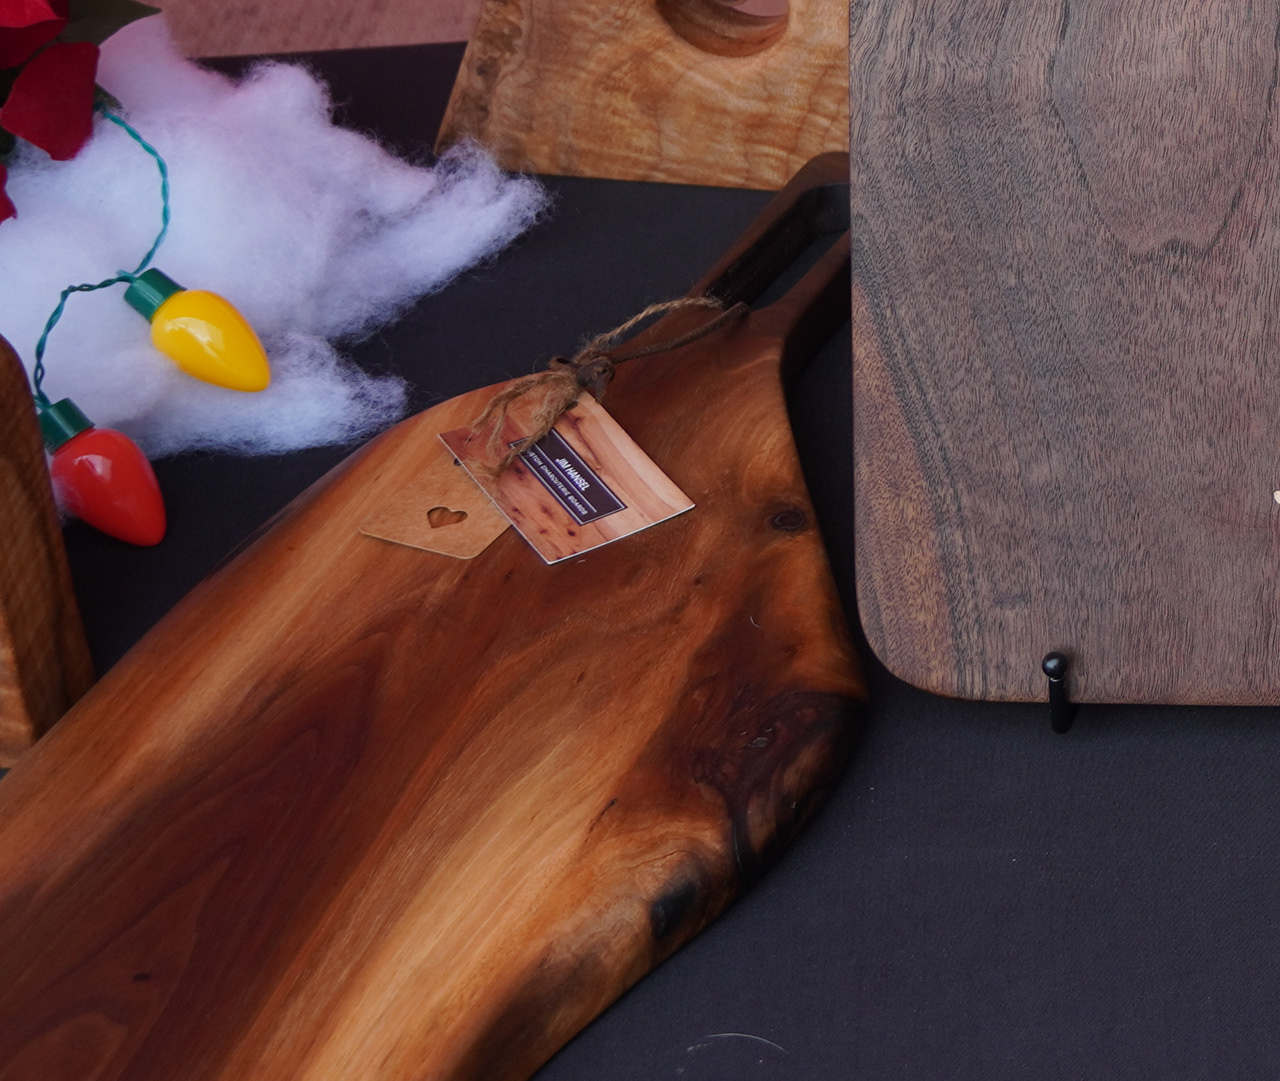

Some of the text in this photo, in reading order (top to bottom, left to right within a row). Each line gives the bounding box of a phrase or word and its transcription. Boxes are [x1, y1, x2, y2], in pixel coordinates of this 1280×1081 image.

[540, 464, 571, 496] CHARCUTERIE
[567, 495, 588, 515] BOARDS
[555, 457, 590, 491] JIM HANSEL
